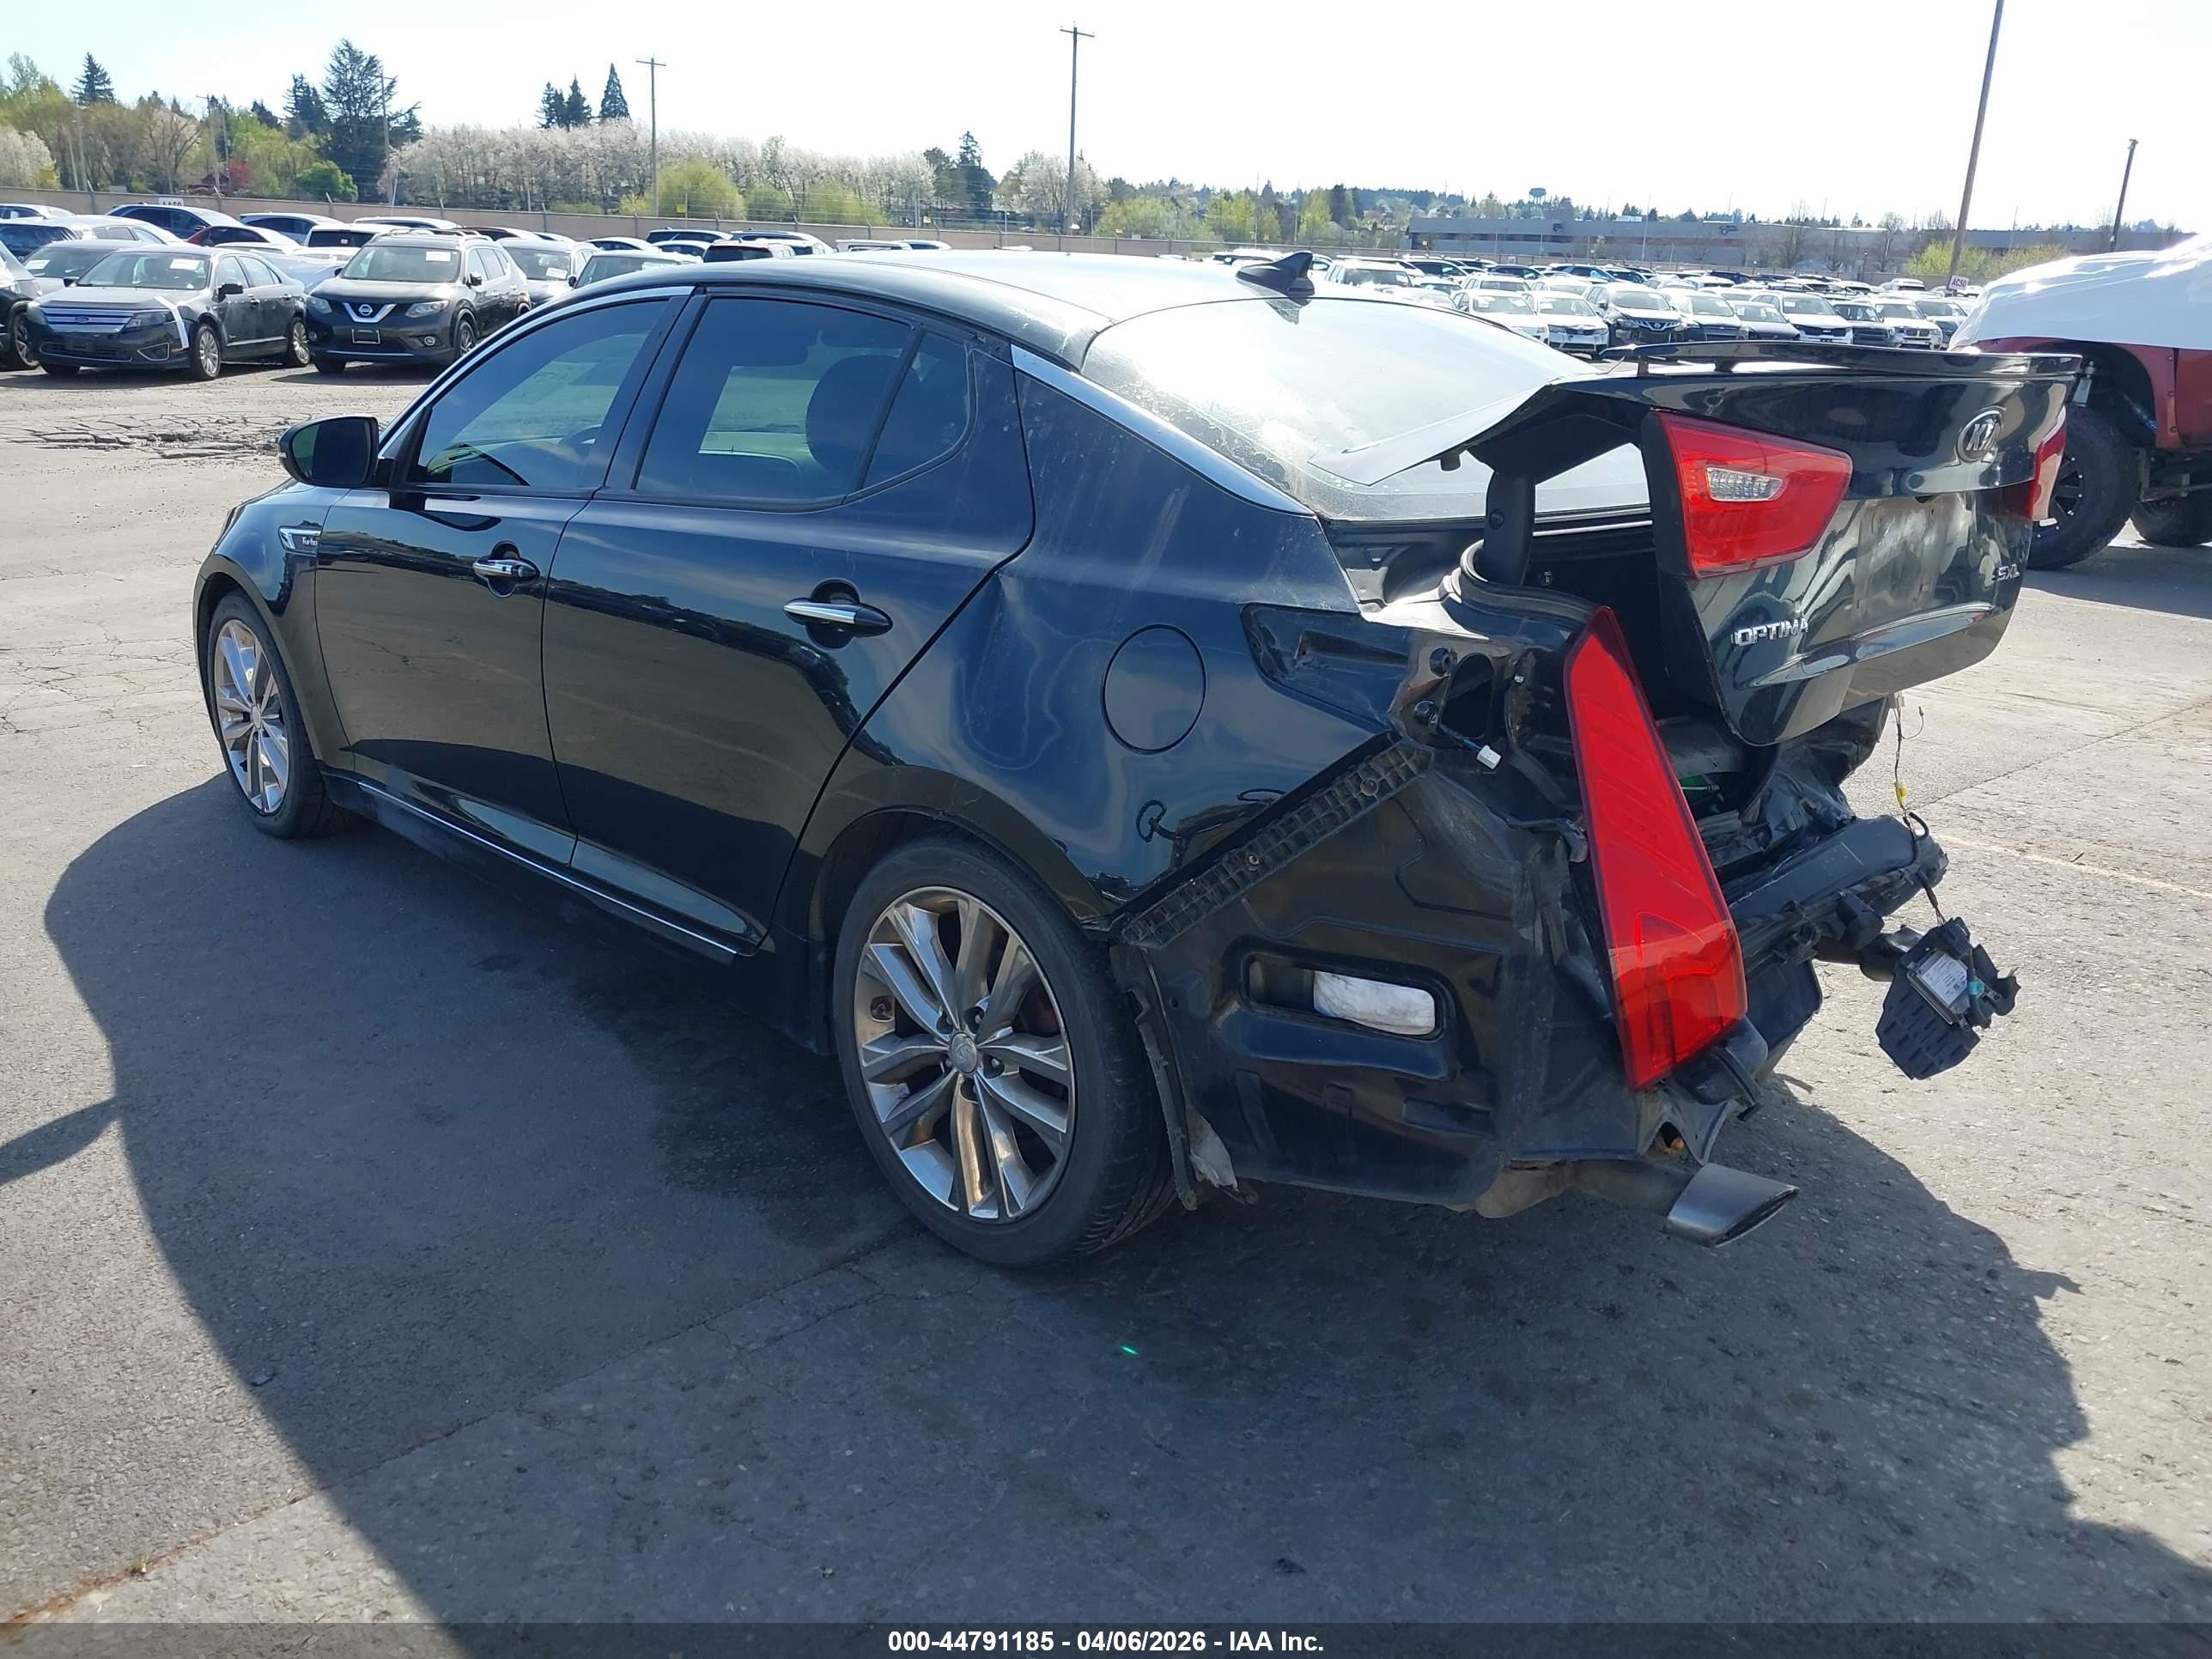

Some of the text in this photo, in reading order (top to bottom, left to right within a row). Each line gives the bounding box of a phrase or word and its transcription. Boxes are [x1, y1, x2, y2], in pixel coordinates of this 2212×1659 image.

[1965, 422, 2001, 451] KIA
[301, 536, 319, 546] Turbo
[1994, 563, 2021, 581] SXL
[1731, 617, 1809, 647] OPTIMA
